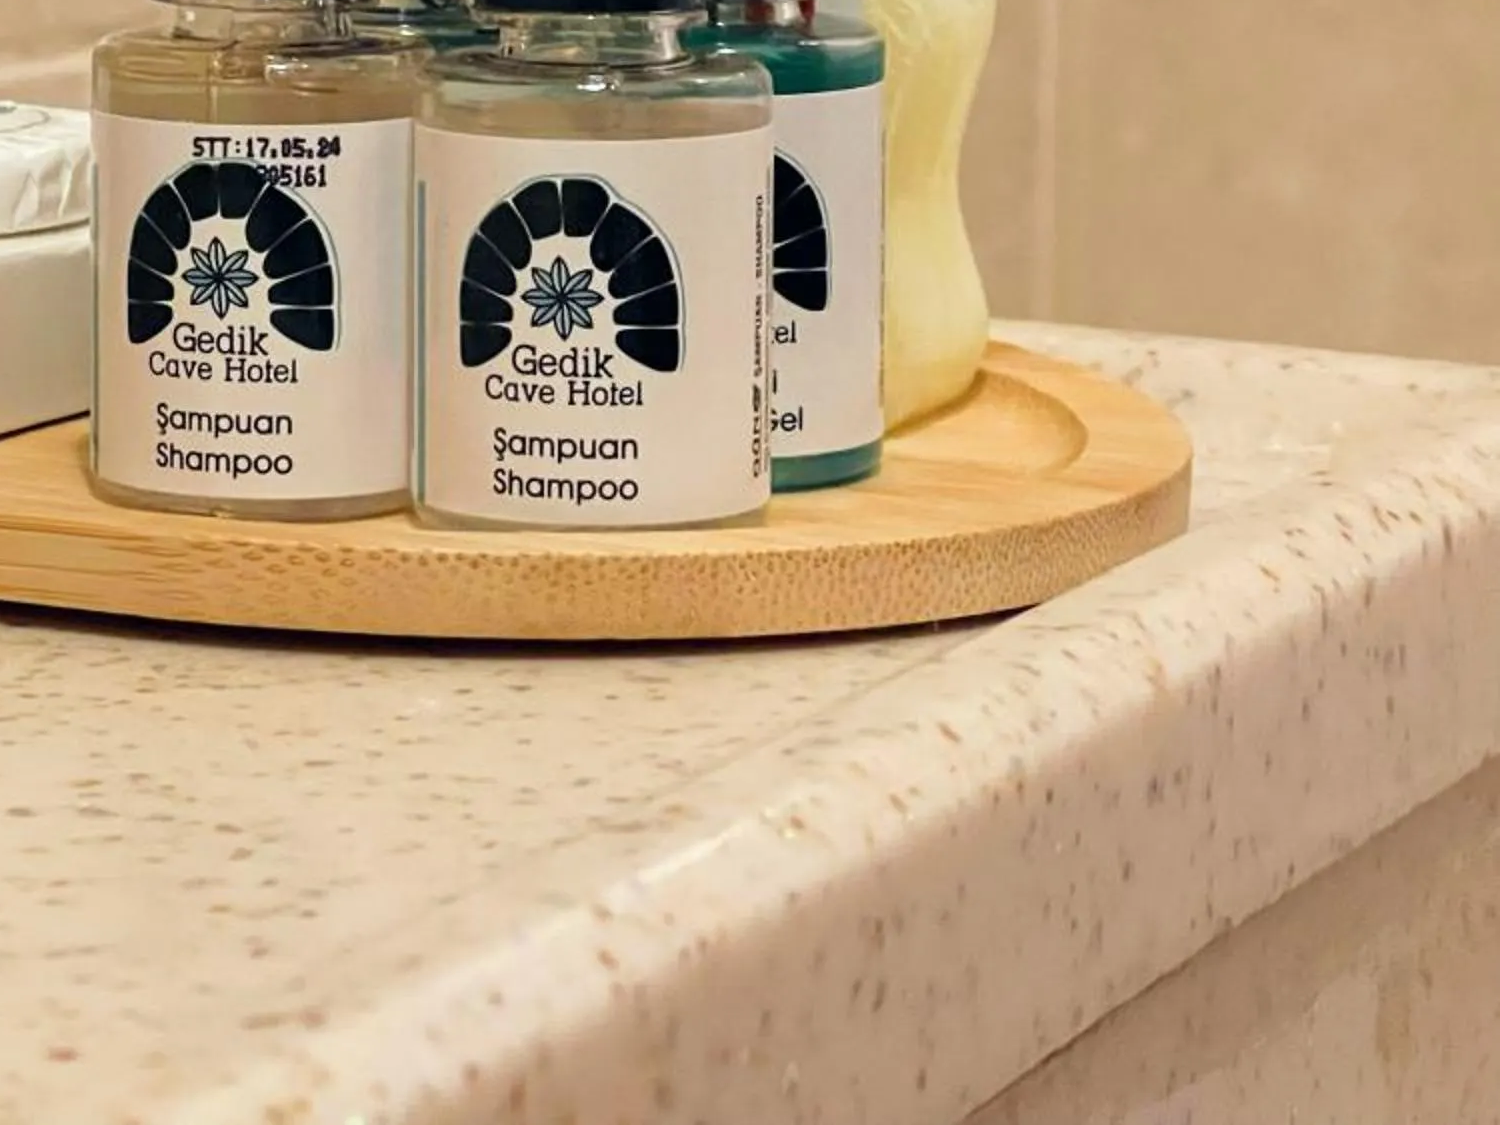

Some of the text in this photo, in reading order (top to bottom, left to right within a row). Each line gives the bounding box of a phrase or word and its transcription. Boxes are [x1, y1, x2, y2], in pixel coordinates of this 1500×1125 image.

[173, 322, 269, 356] Gedik
[148, 352, 298, 384] Cave Hotel
[512, 344, 614, 378] Gedik
[485, 375, 643, 407] Cave Hotel
[156, 402, 293, 437] Şampuan
[156, 442, 293, 479] Shampoo
[493, 427, 638, 464] Şampuan
[493, 468, 638, 506] Shampoo
